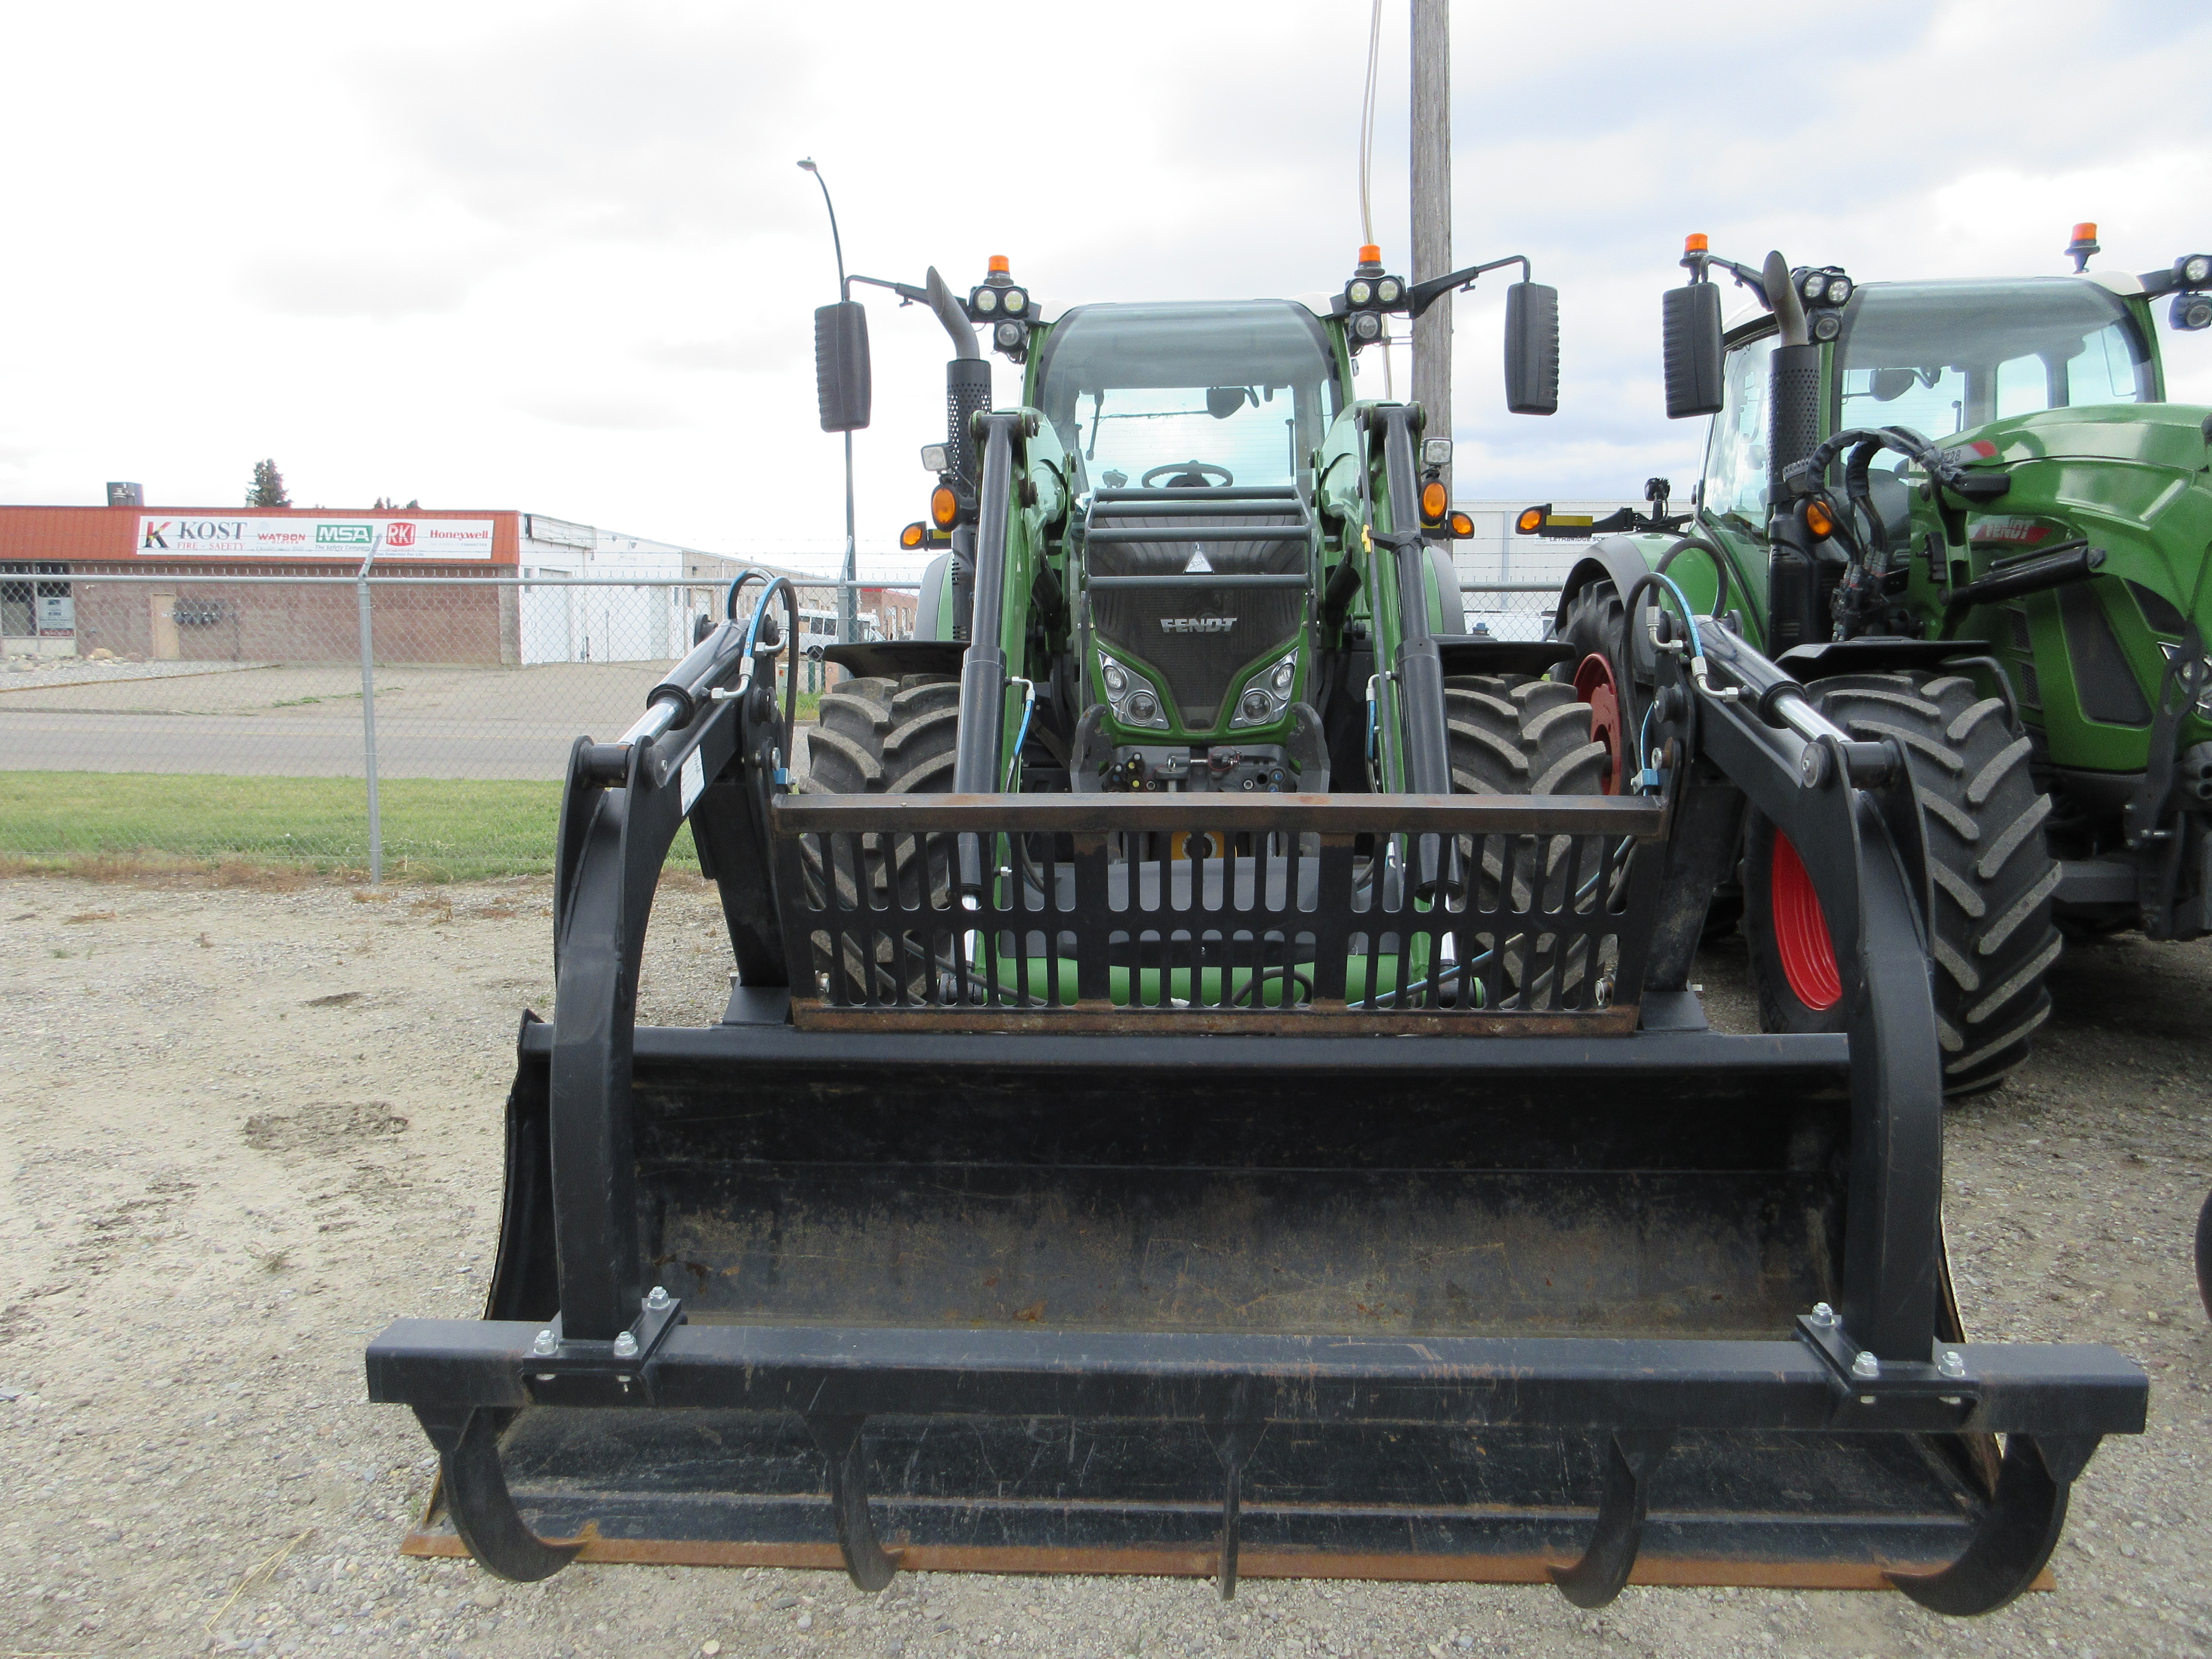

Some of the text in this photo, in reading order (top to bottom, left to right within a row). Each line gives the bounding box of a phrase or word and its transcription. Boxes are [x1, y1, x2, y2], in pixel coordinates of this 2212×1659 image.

[178, 521, 247, 540] KOST
[319, 527, 370, 541] MSA
[387, 525, 415, 543] RKI
[430, 530, 489, 541] Honeywell
[1160, 617, 1238, 633] FENDT
